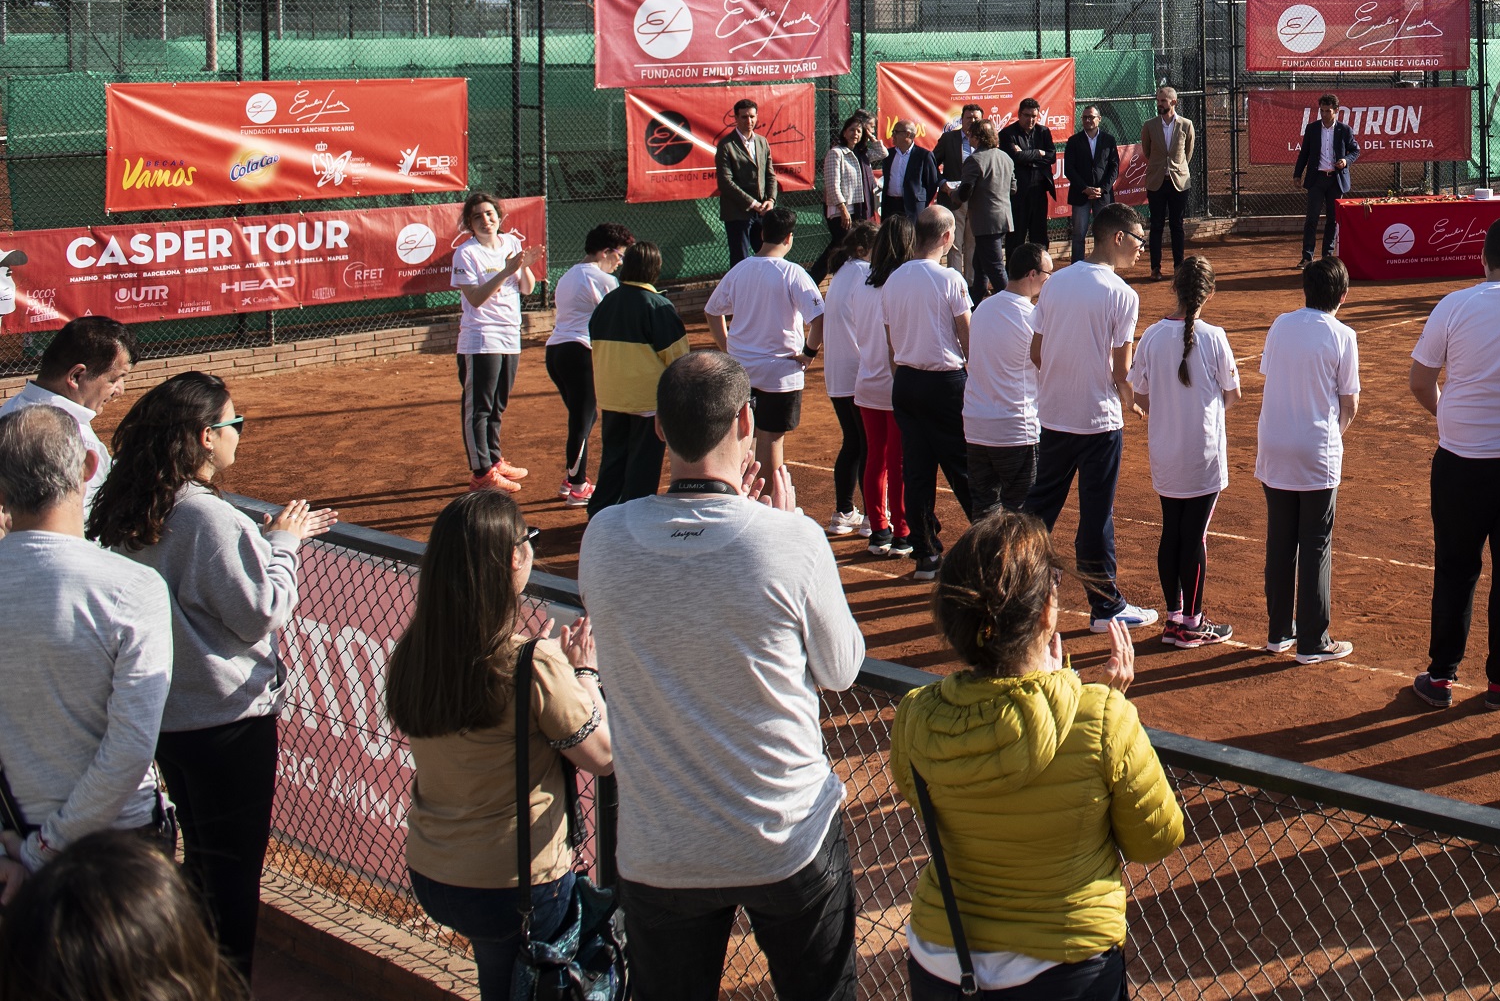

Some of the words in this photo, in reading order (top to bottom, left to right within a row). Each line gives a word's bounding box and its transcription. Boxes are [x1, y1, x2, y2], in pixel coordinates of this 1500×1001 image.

[1281, 59, 1331, 68] FUNDACIÓN
[1334, 59, 1363, 67] EMILIO
[1365, 57, 1404, 67] SÁNCHEZ
[1406, 58, 1439, 66] VICARIO
[640, 65, 699, 80] FUNDACIÓN
[702, 66, 734, 77] EMILIO
[737, 62, 780, 75] SÁNCHEZ
[783, 61, 818, 75] VICARIO
[1300, 104, 1423, 137] LOTRON
[1364, 140, 1386, 150] DEL
[1388, 139, 1434, 149] TENISTA
[146, 159, 185, 168] BECAS
[416, 155, 450, 169] ADB
[122, 157, 197, 190] Vamos
[650, 172, 699, 184] FUNDACIÓN
[66, 228, 233, 269] CASPER
[242, 219, 350, 256] TOUR
[1386, 257, 1419, 265] FUNDACIÓN
[1441, 254, 1466, 262] SÁNCHEZ
[69, 275, 99, 283] NANJING
[103, 273, 119, 281] NEW
[142, 269, 181, 278] BARCELONA
[185, 266, 209, 274] MADRID
[245, 261, 270, 269] ATLANTA
[354, 267, 385, 281] RFET
[398, 267, 438, 278] FUNDACIÓN
[220, 276, 296, 293] HEAD
[26, 288, 56, 299] LOCOS
[131, 285, 169, 301] UTR
[177, 305, 212, 314] MAPFRE
[180, 299, 211, 307] Fundación
